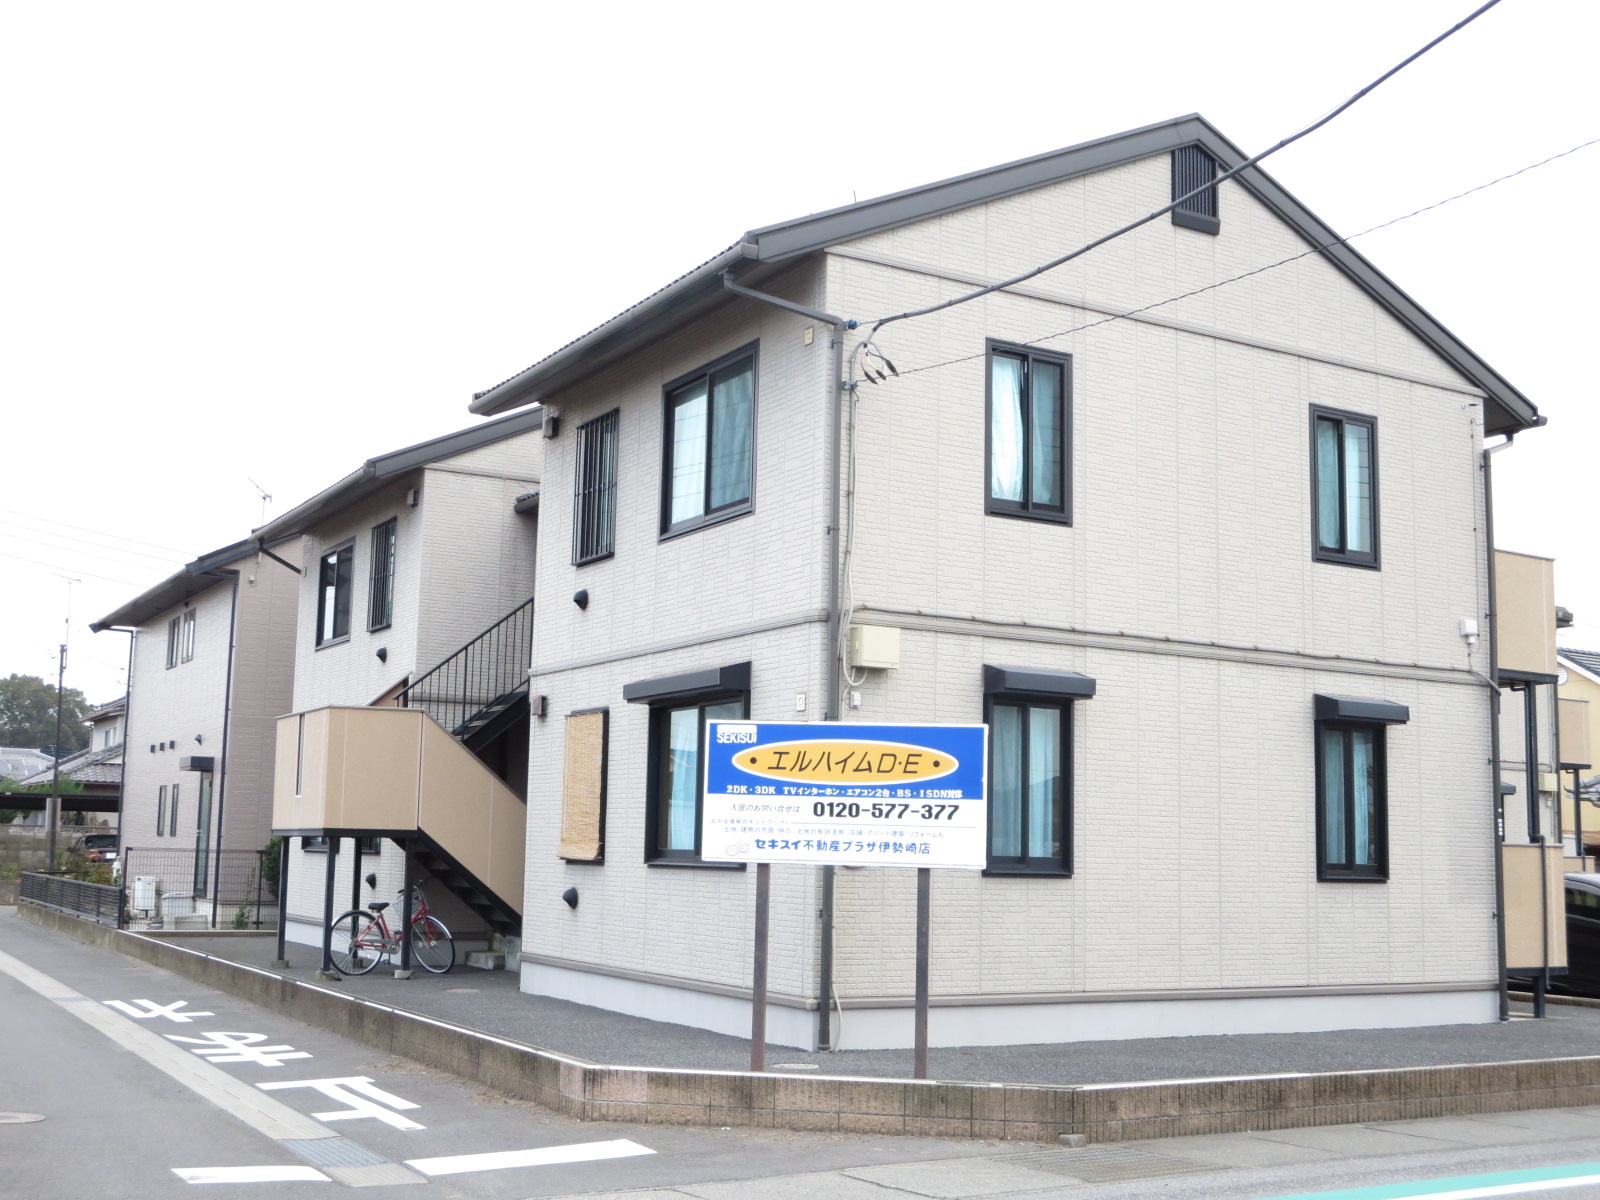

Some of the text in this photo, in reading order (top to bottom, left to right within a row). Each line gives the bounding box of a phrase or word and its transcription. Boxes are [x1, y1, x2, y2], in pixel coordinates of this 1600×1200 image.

[716, 733, 758, 744] SEKISUI
[729, 803, 801, 813] 入居のお問い合せは
[812, 801, 960, 821] 0120-577-377
[754, 838, 931, 855] セキスイ不動産プラザ伊勢崎店
[101, 997, 428, 1132] 止まれ
